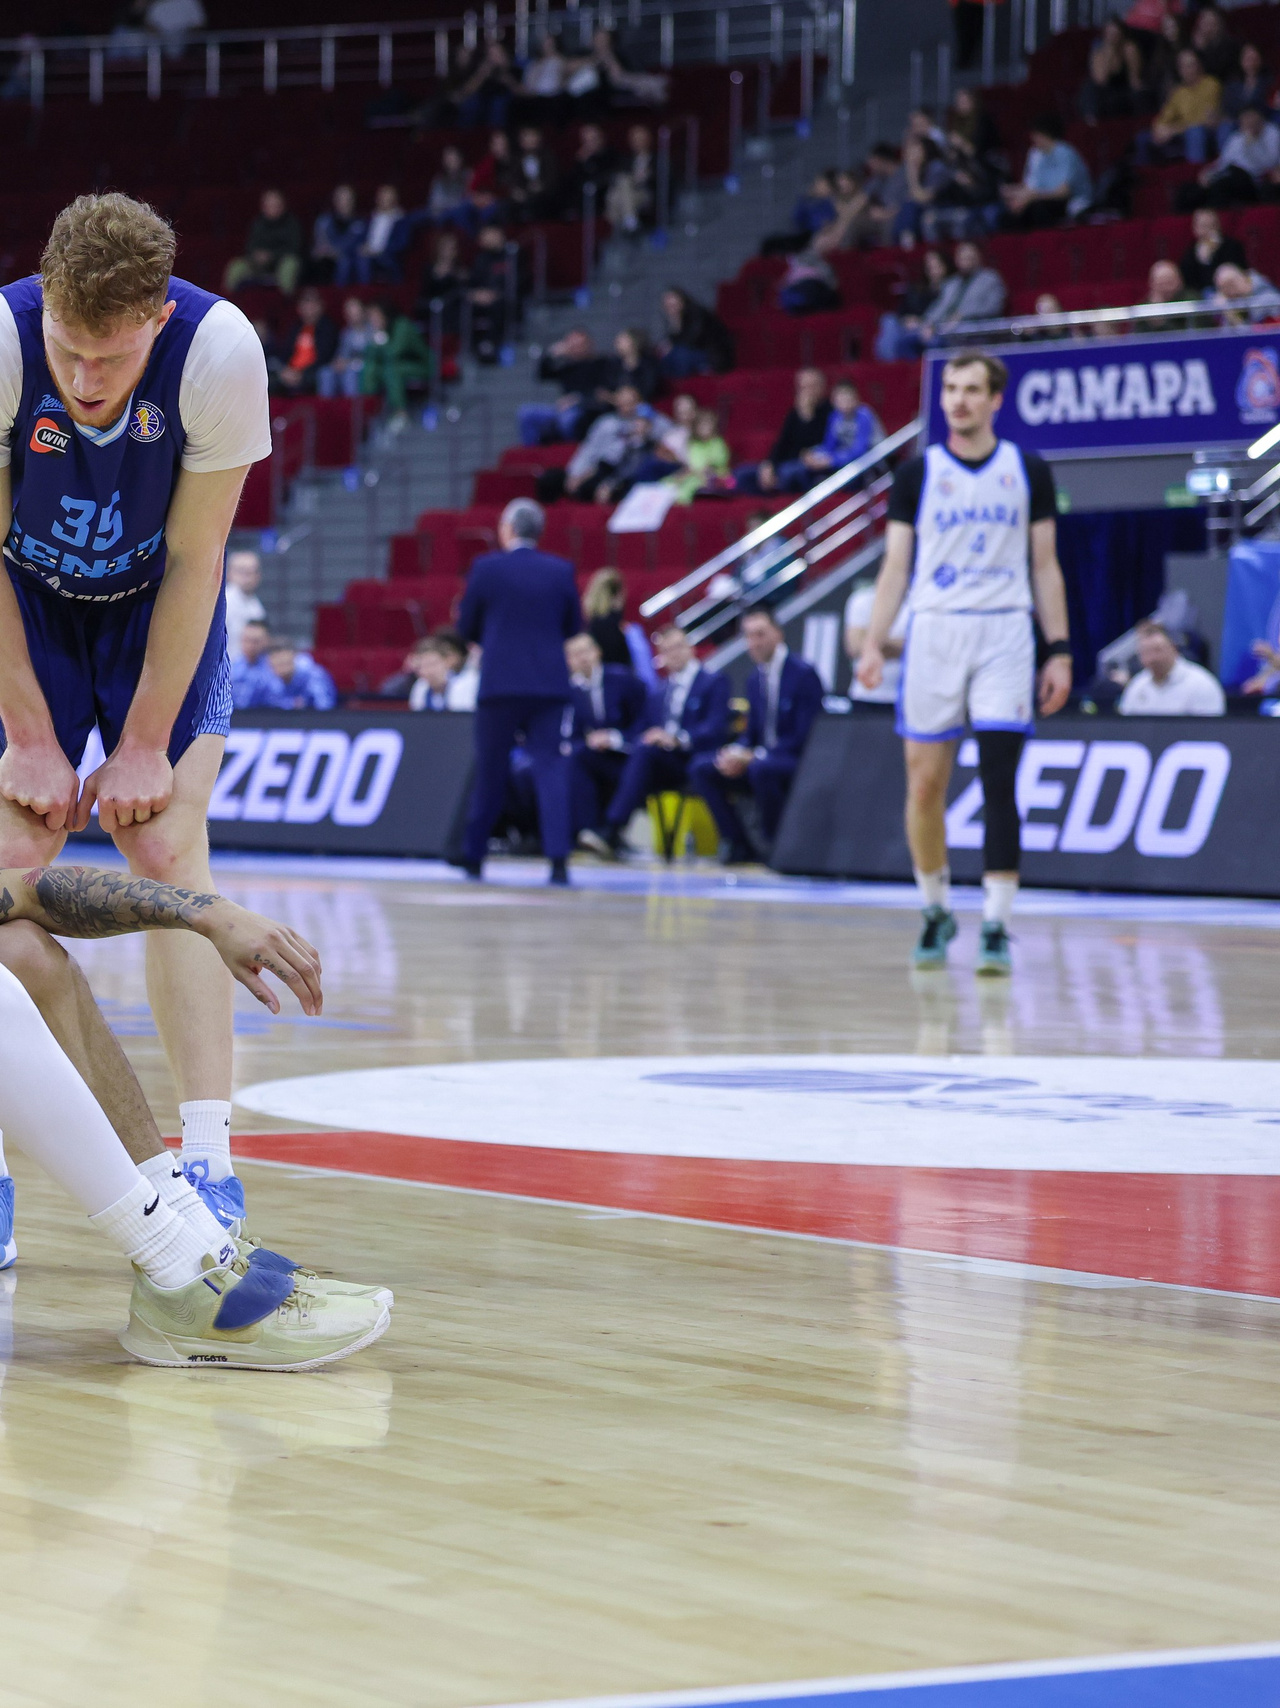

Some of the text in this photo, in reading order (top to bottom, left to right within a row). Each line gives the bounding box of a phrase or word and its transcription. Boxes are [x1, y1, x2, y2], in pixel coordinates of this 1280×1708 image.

[1016, 359, 1217, 426] САМАРА
[41, 430, 68, 448] WIN
[51, 490, 123, 551] 35
[206, 727, 405, 827] ZEDO
